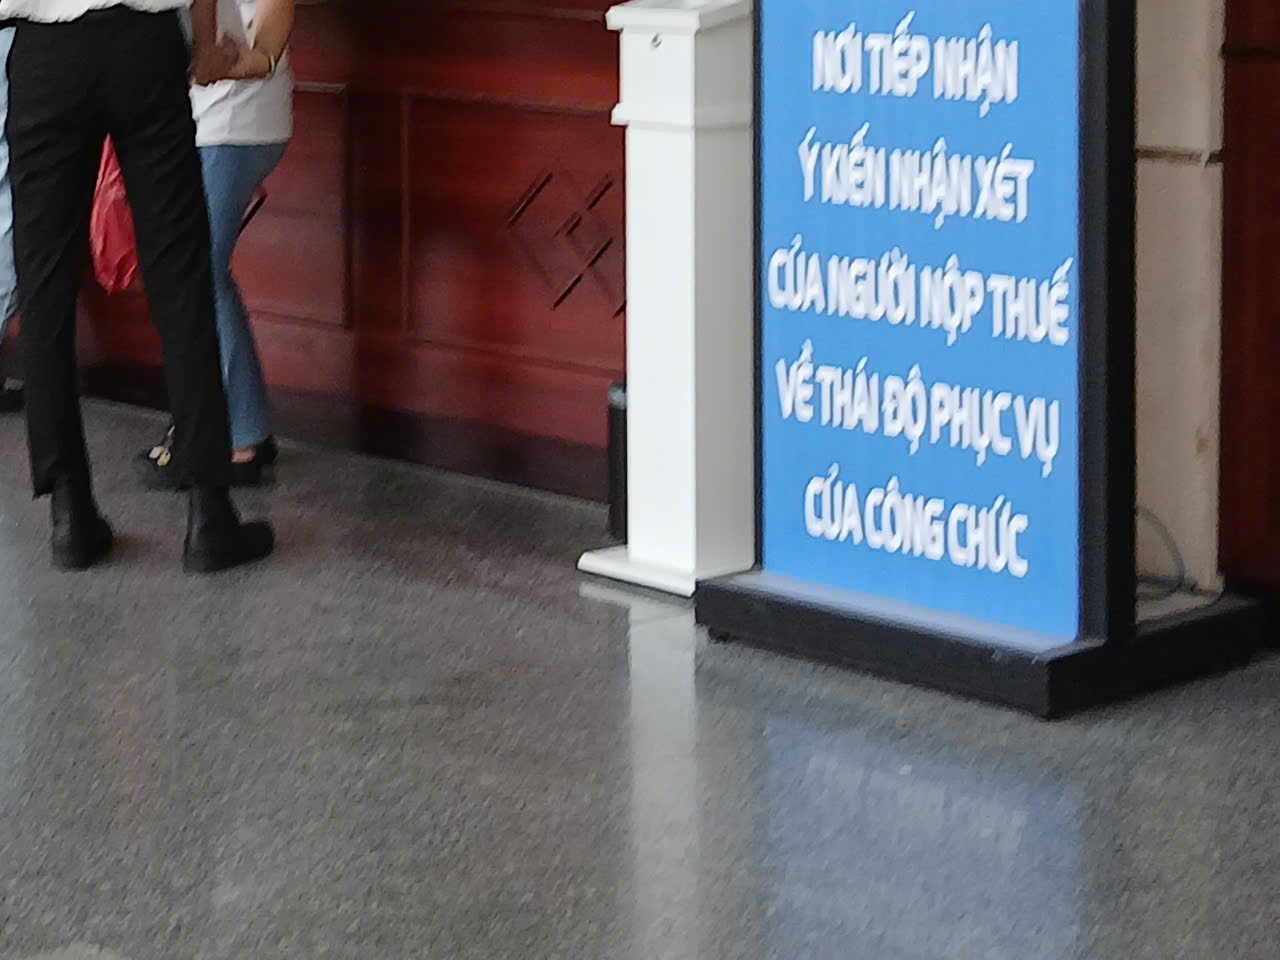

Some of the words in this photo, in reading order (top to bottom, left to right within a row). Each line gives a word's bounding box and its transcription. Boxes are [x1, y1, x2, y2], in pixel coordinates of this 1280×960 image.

[813, 21, 862, 94] NƠI
[864, 10, 931, 97] TIẾP
[933, 23, 1018, 118] NHẬN
[798, 126, 821, 202] Ý
[821, 121, 886, 209] KIẾN
[889, 136, 971, 230] NHẬN
[972, 142, 1035, 223] XÉT
[769, 233, 825, 315] CỦA
[827, 246, 916, 326] NGƯỜI
[920, 253, 984, 346] NỘP
[986, 256, 1073, 346] THUẾ
[775, 338, 814, 423] VỀ
[815, 356, 880, 434] THÁI
[881, 363, 927, 456] ĐỘ
[930, 381, 1012, 467] PHỤC
[1013, 394, 1060, 478] VỤ
[804, 462, 864, 546] CỦA
[864, 475, 946, 560] CÔNG
[947, 494, 1029, 578] CHỨC
